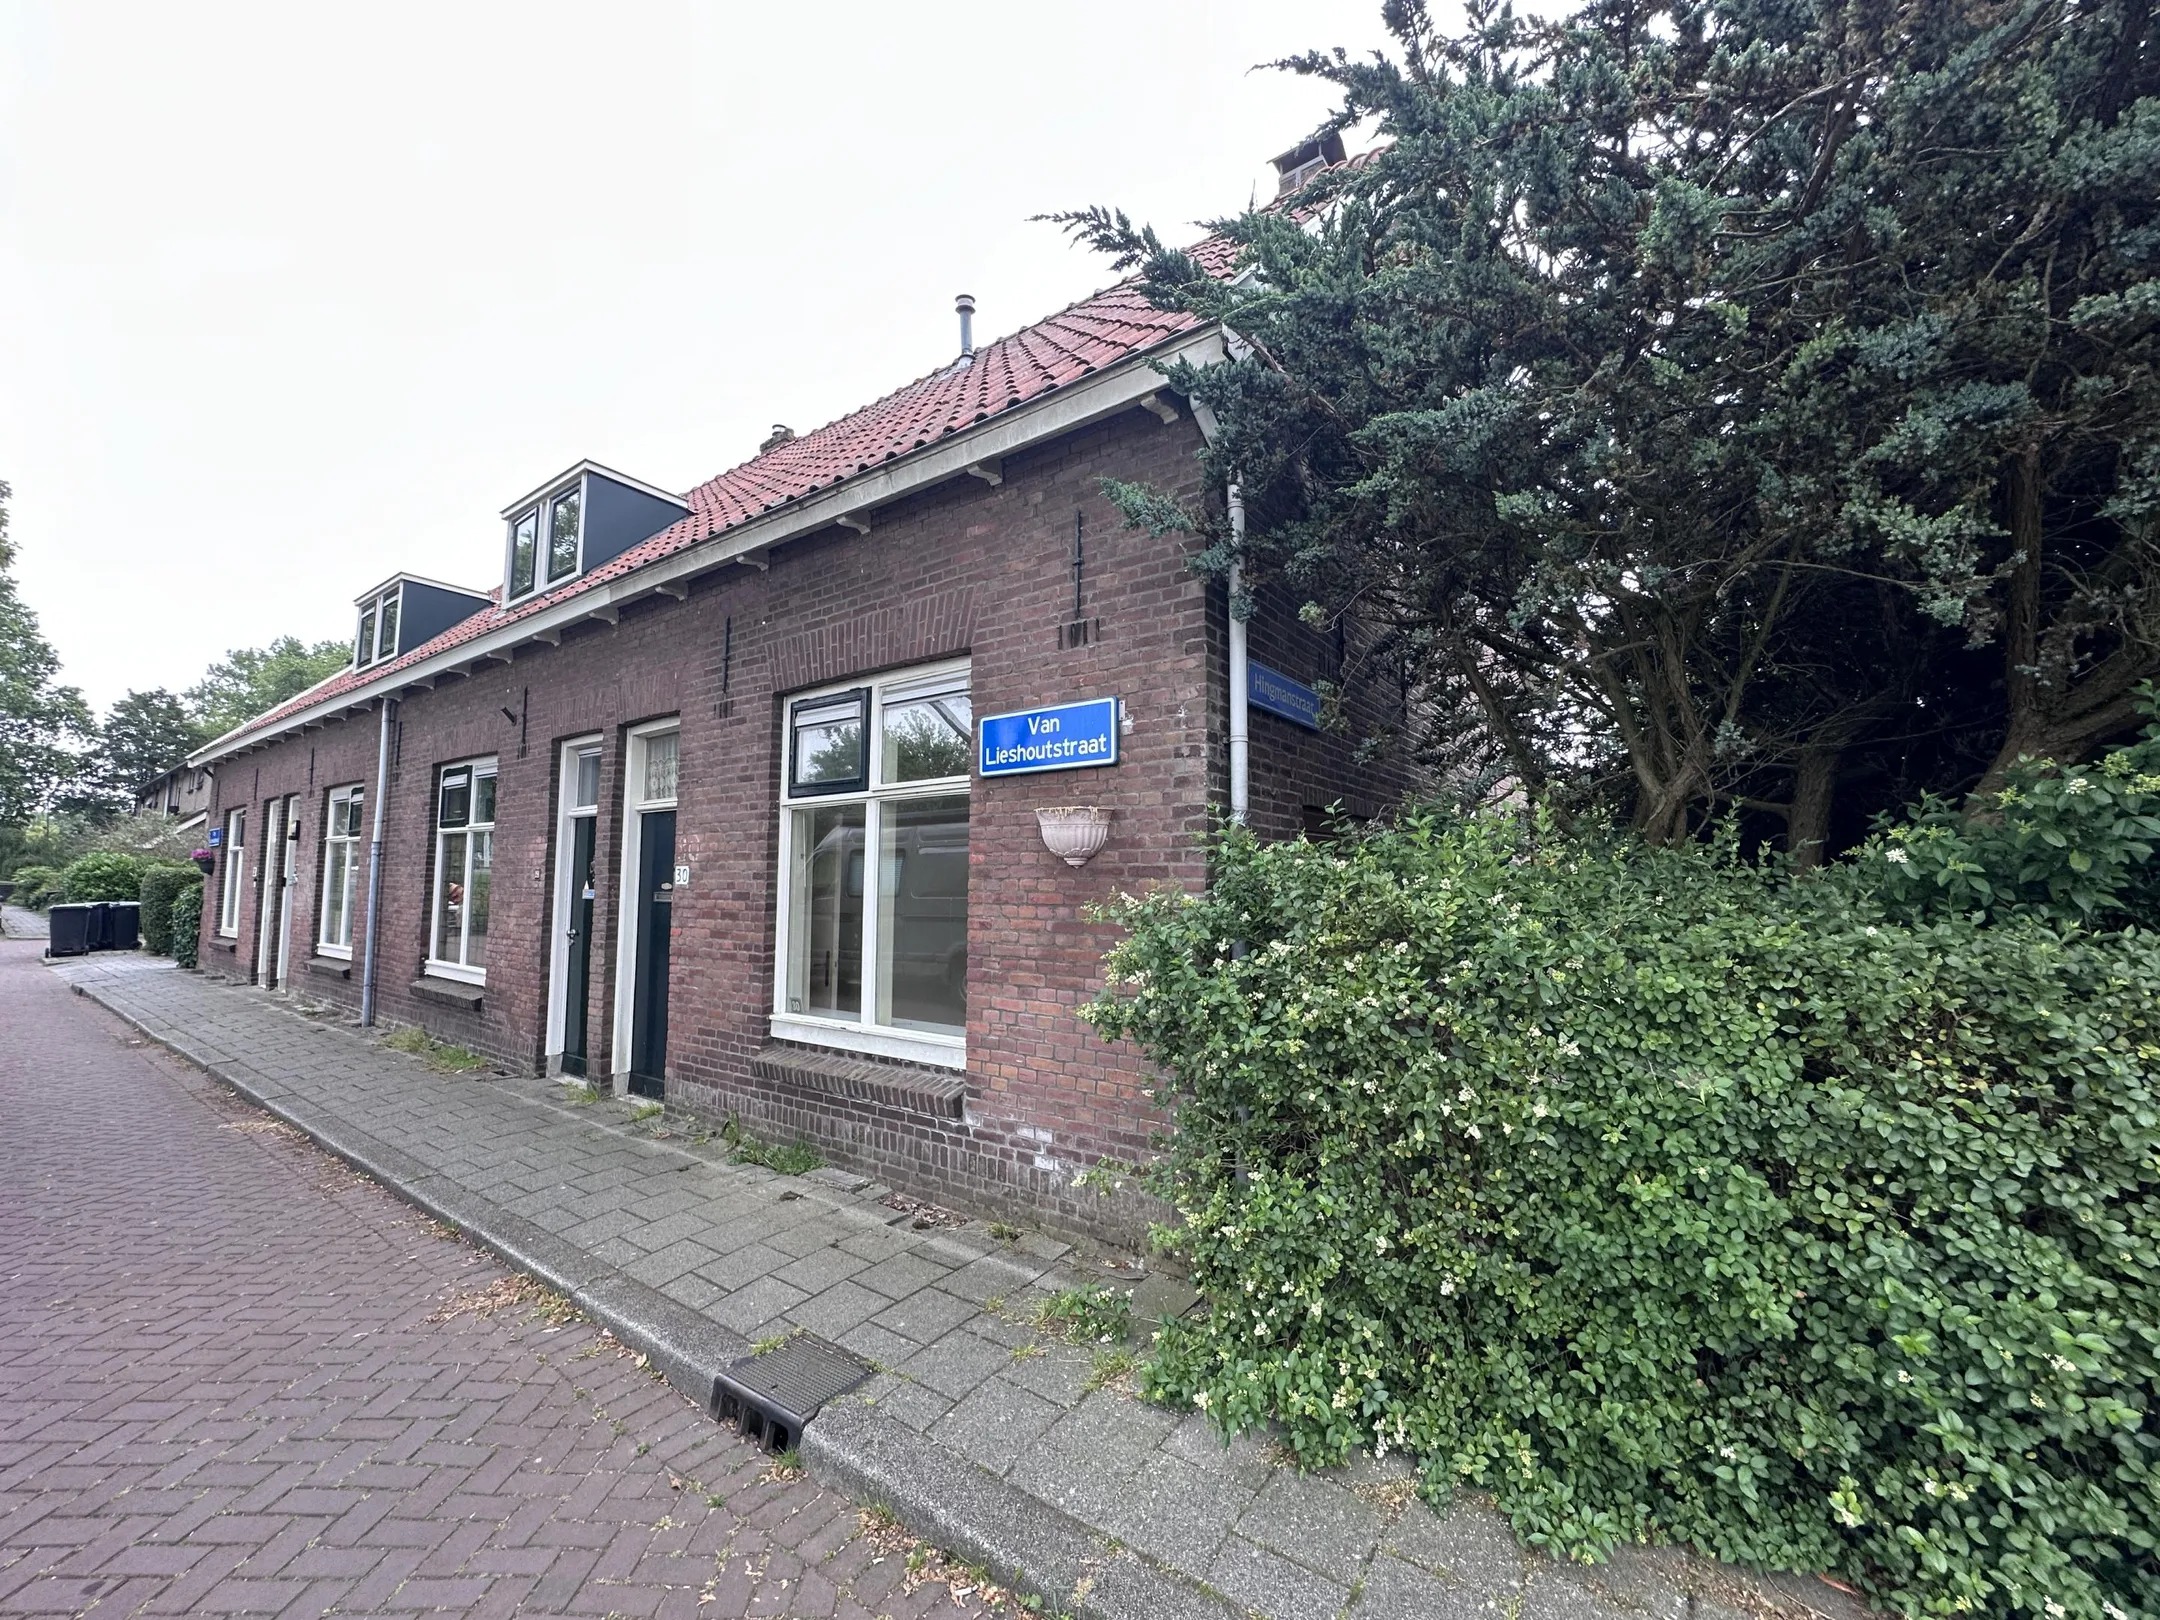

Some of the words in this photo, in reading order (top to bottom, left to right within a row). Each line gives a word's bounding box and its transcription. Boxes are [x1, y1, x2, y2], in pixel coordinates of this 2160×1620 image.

[1254, 672, 1314, 714] Hingmanstraat
[1028, 716, 1060, 735] Van
[985, 733, 1107, 766] Lieshoutstraat
[676, 868, 688, 882] 30
